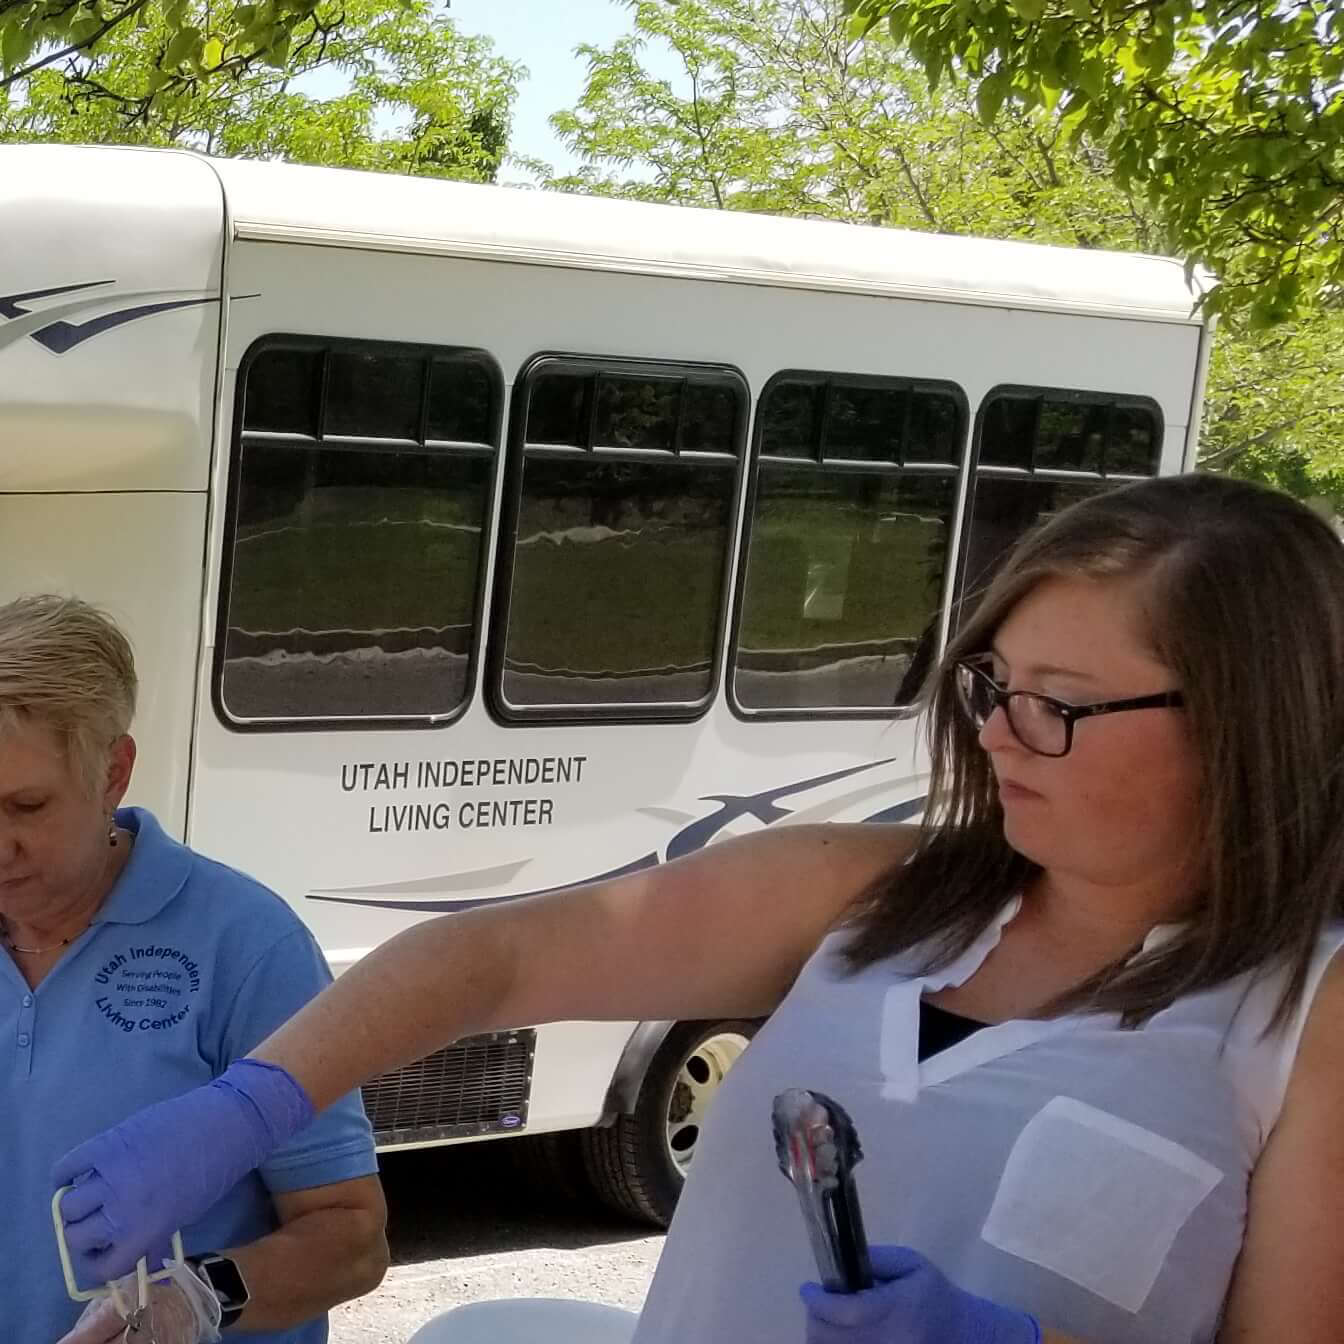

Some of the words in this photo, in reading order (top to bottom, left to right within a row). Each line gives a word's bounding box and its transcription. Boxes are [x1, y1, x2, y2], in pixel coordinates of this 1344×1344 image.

[341, 761, 410, 792] UTAH
[416, 756, 587, 788] INDEPENDENT
[368, 803, 451, 833] LIVING
[458, 798, 554, 828] CENTER
[95, 953, 128, 985] Utah
[129, 944, 201, 993] Independent
[116, 983, 136, 992] With
[95, 997, 136, 1033] Living
[138, 1003, 191, 1031] Center
